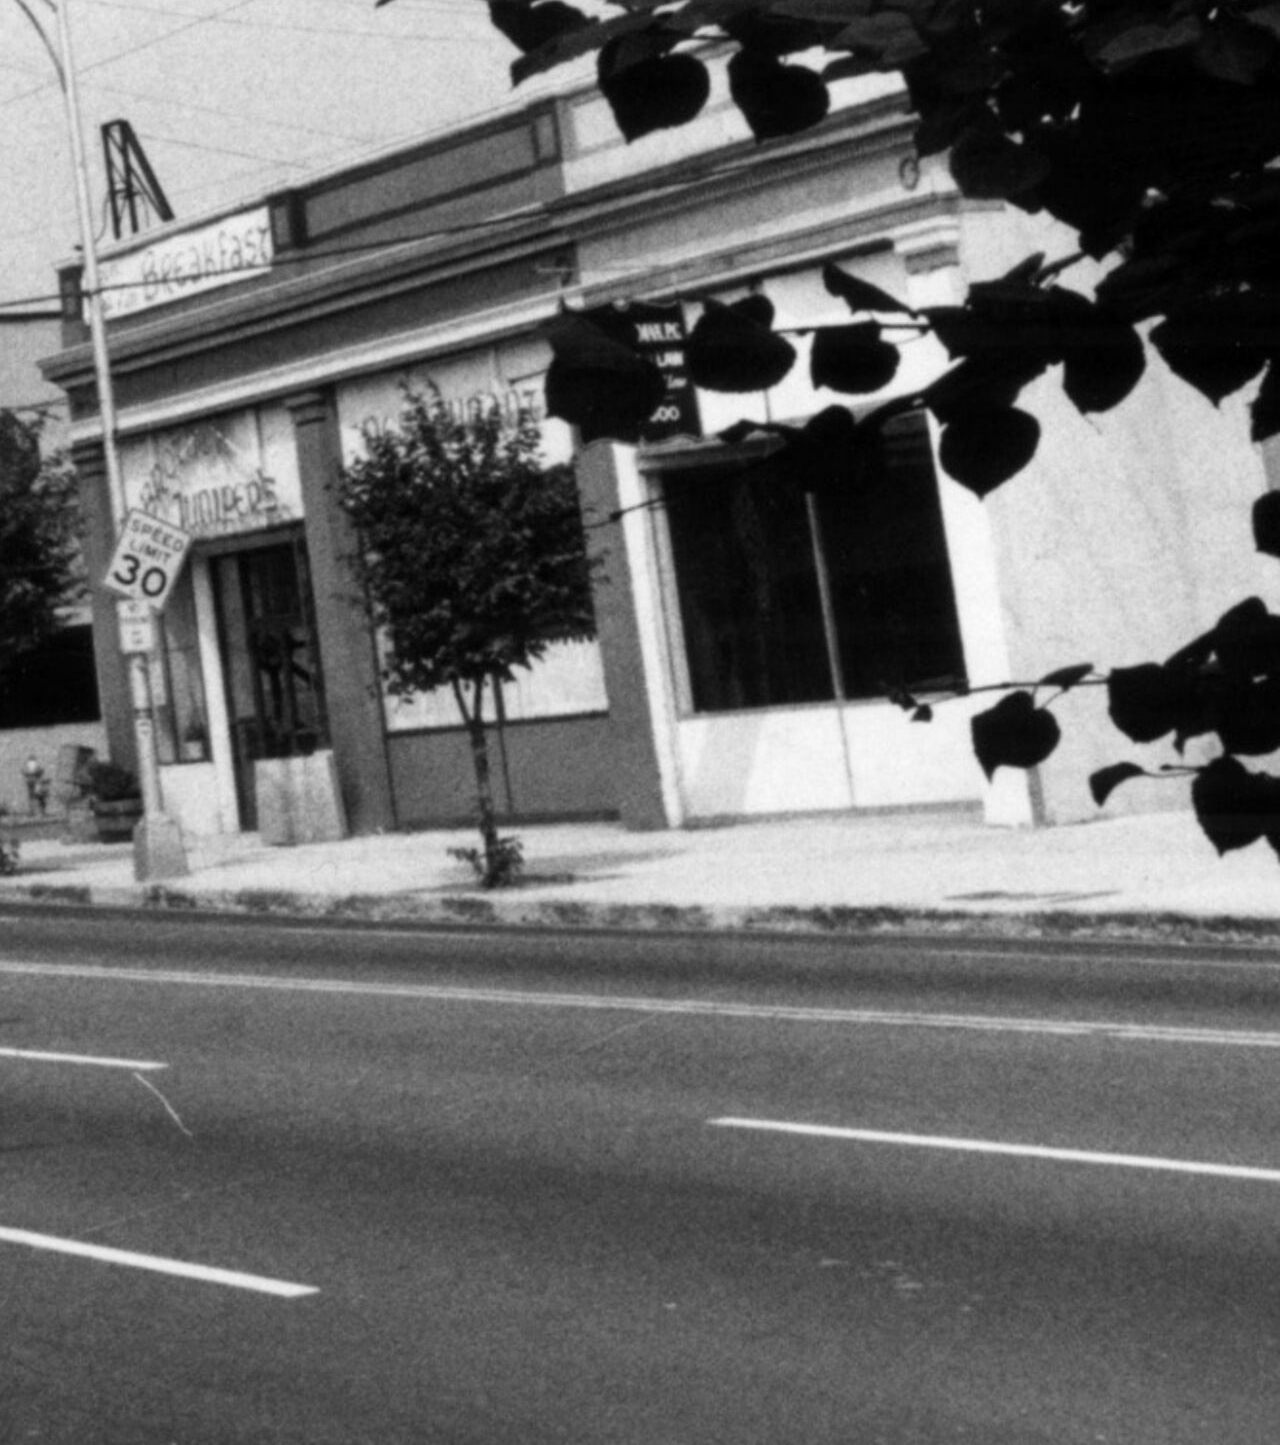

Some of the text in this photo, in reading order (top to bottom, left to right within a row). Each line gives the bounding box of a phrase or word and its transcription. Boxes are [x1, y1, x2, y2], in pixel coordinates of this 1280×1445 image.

[129, 539, 172, 564] LIMIT
[132, 519, 184, 552] SPEED
[113, 554, 167, 597] 30
